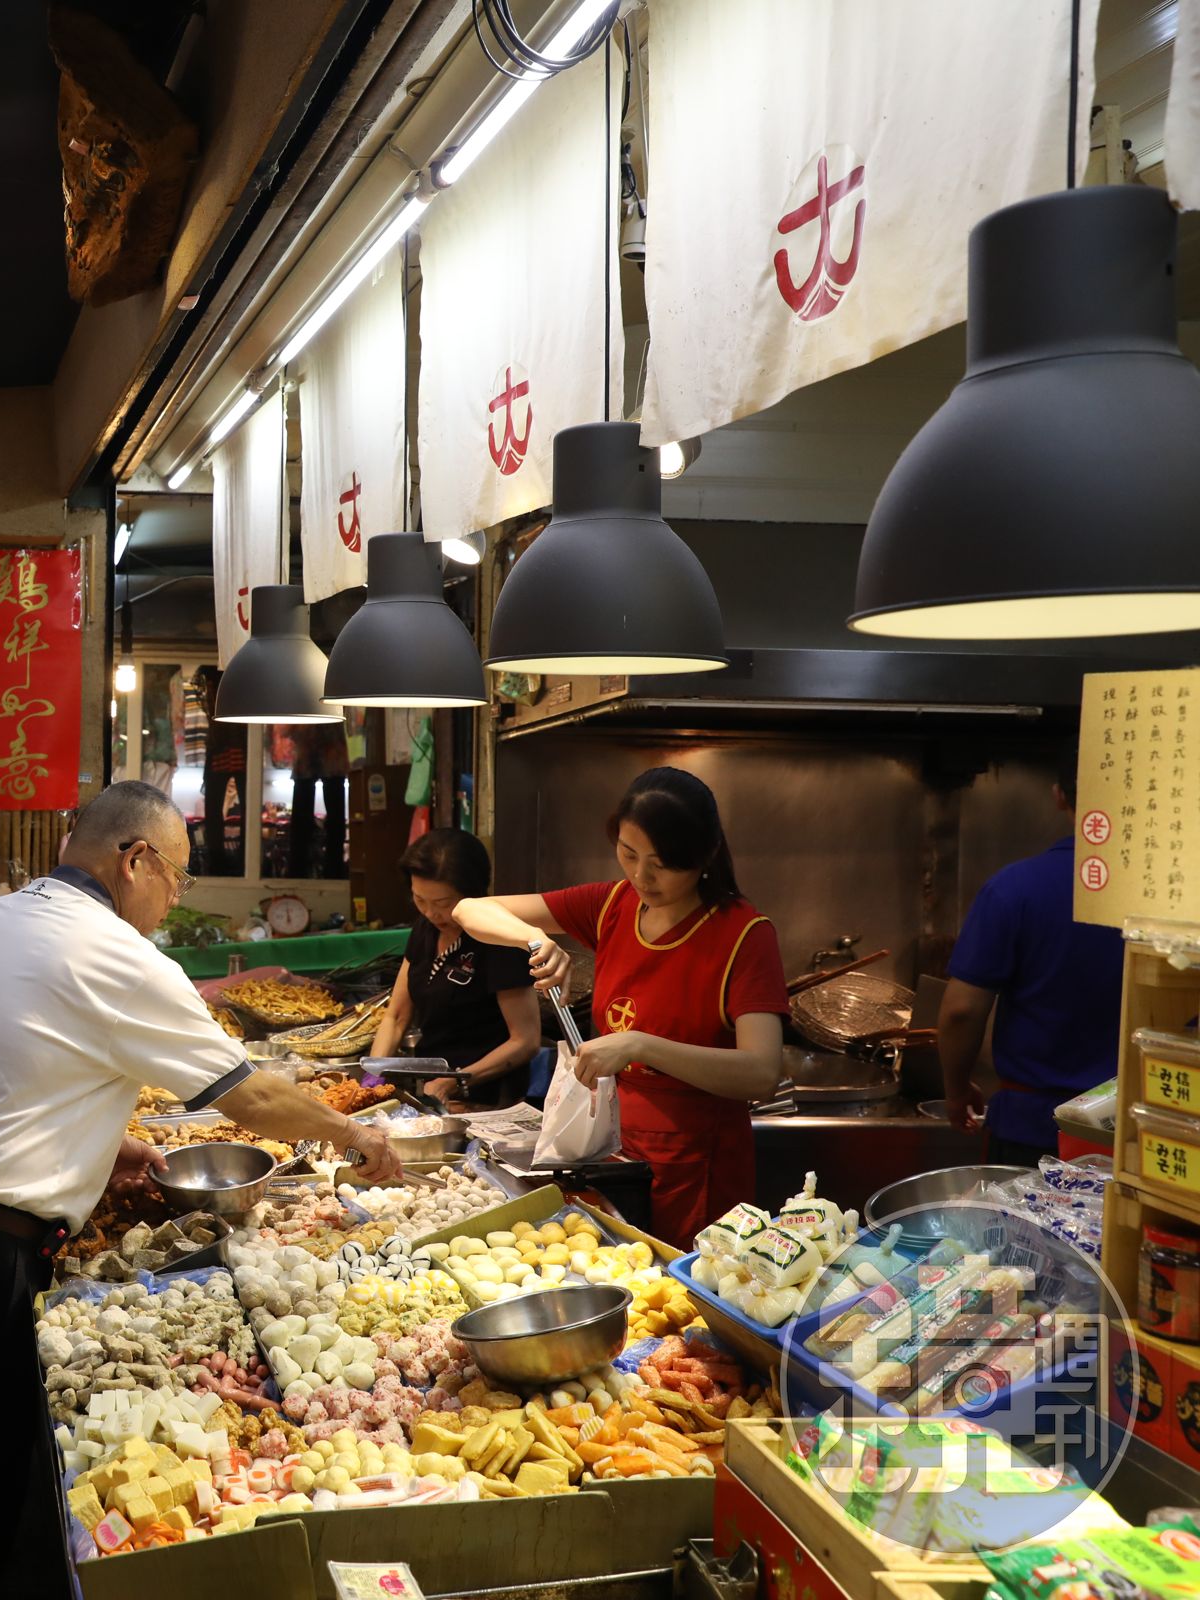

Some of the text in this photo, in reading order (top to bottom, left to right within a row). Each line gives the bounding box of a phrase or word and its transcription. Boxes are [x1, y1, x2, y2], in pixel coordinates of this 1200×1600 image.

[1085, 815, 1107, 839] 老
[1160, 1068, 1173, 1098] みそ
[1175, 1070, 1190, 1102] 信州
[1156, 1143, 1170, 1174] みそ
[1173, 1147, 1187, 1179] 信州
